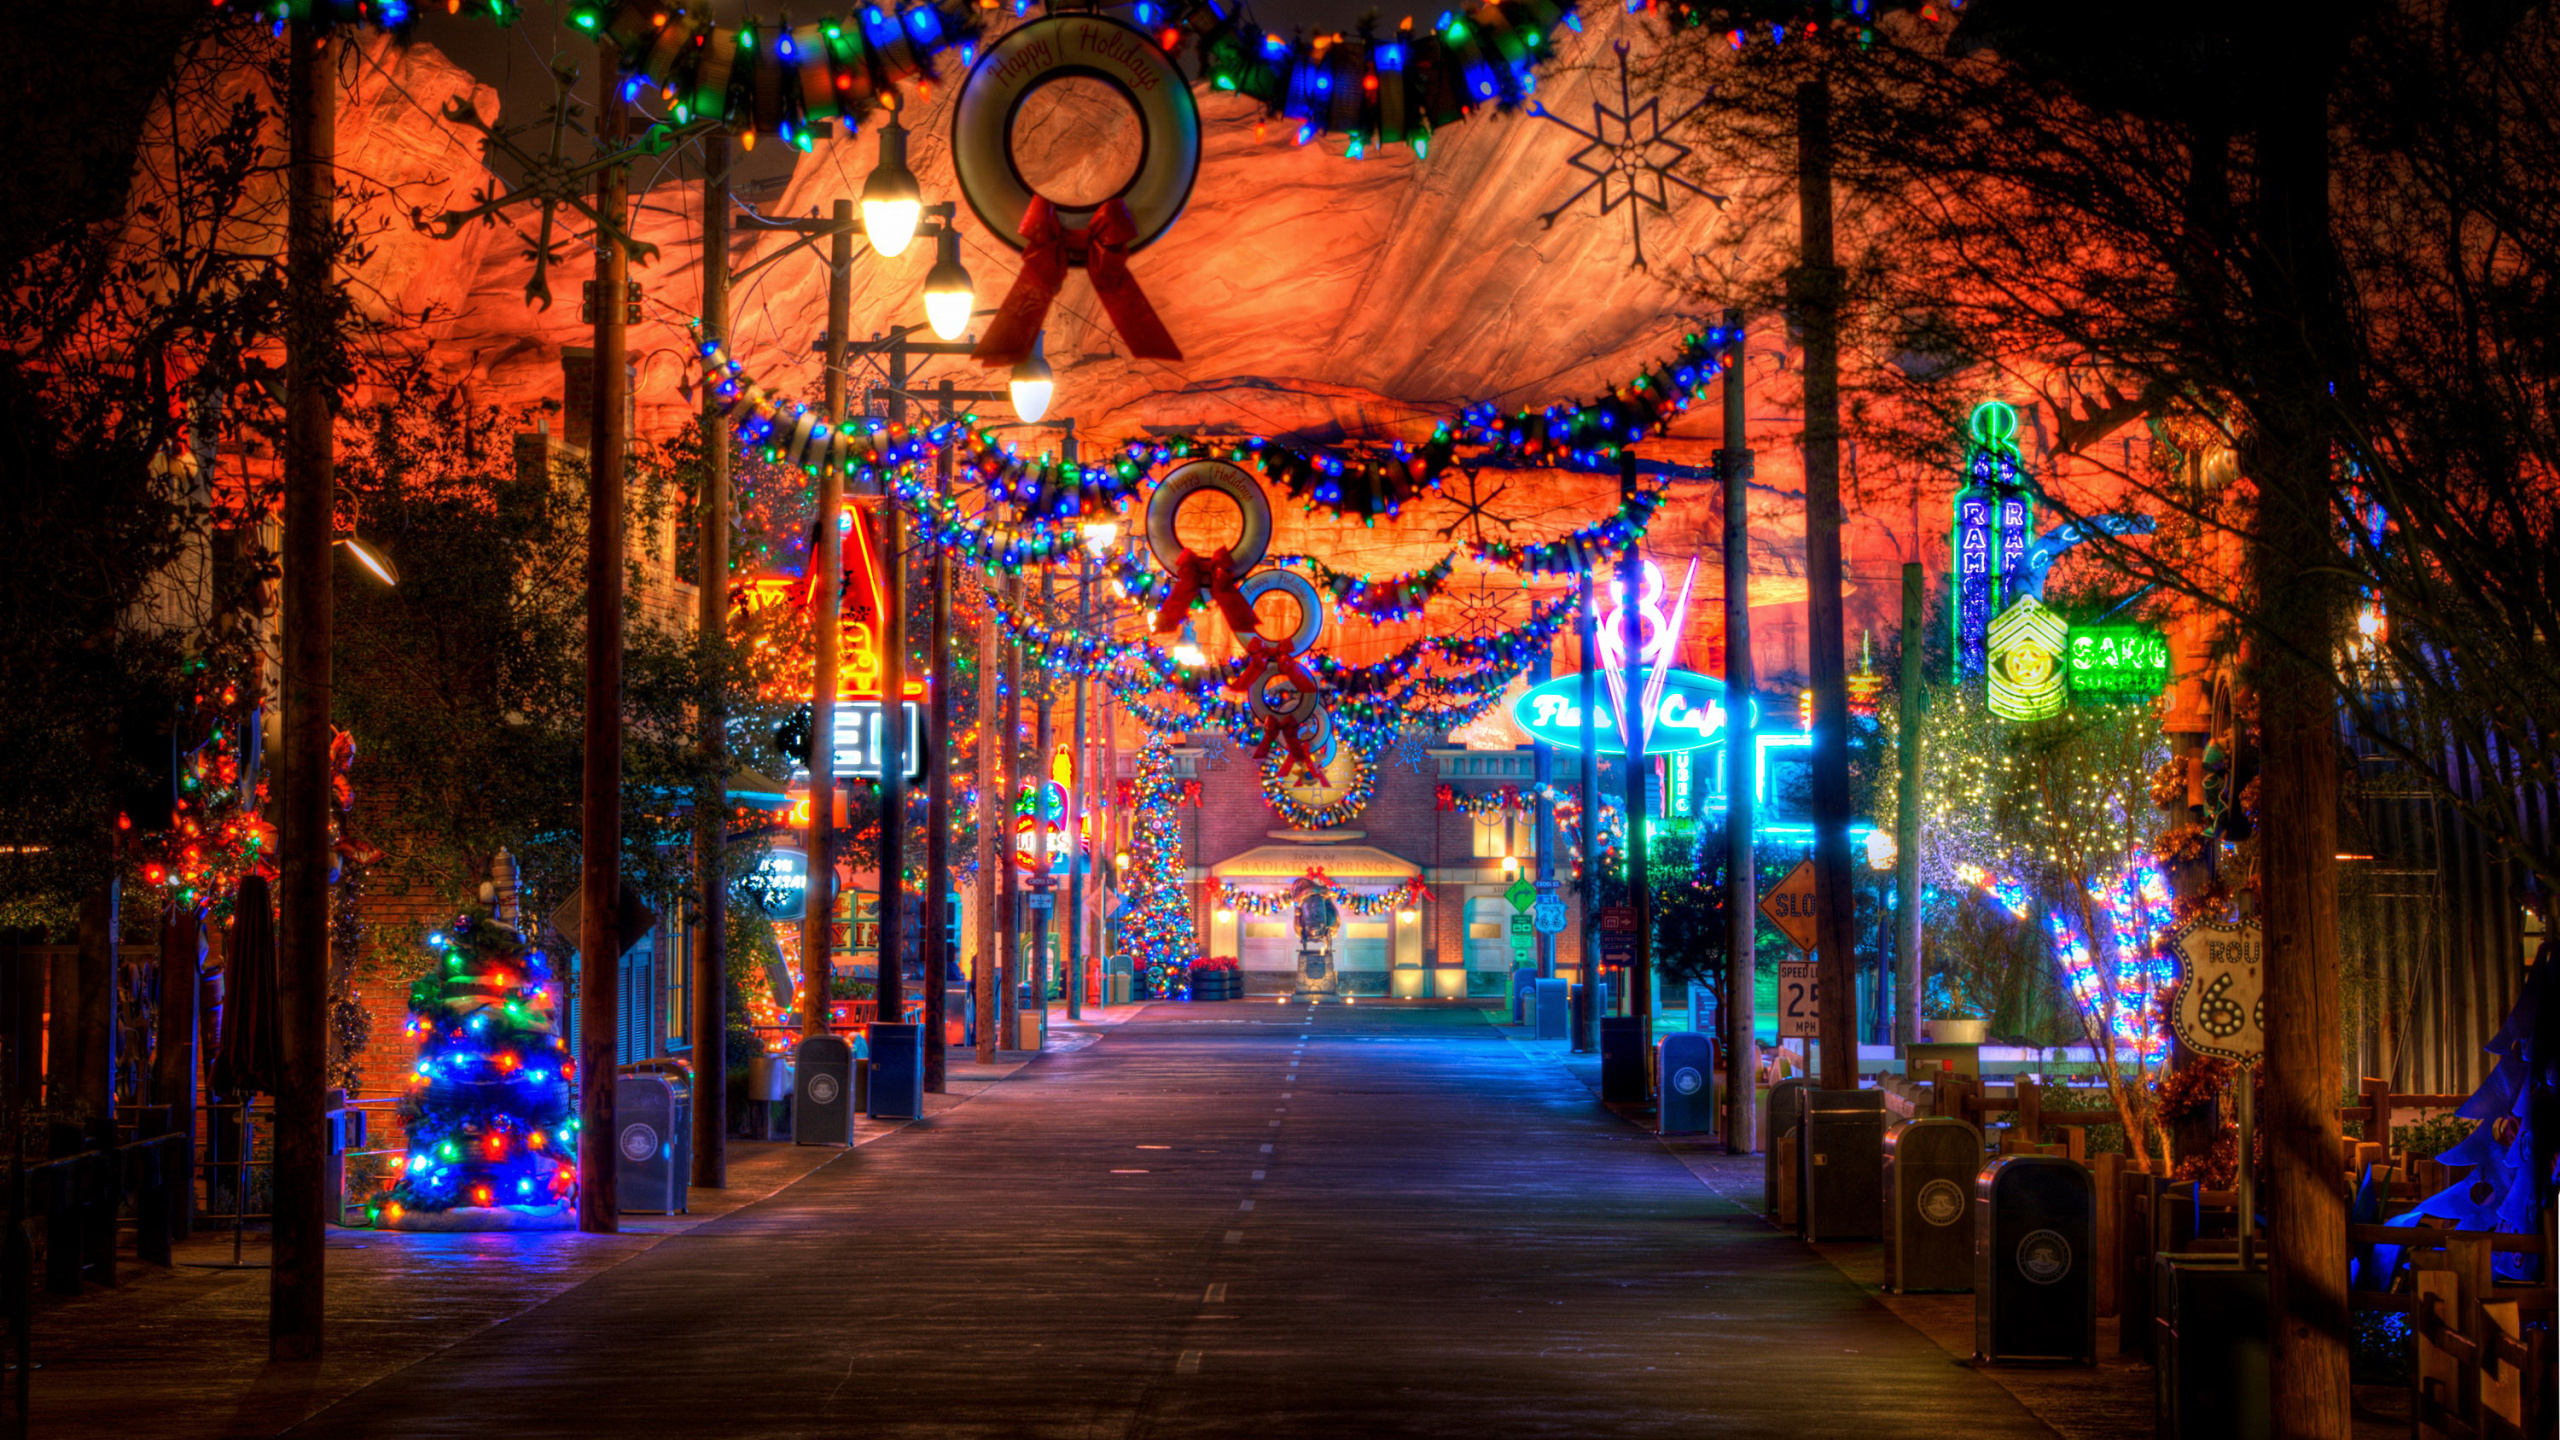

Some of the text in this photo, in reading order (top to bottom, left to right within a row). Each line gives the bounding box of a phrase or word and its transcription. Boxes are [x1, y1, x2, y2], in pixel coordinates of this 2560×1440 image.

[987, 24, 1159, 91] Happy Holidays
[1168, 465, 1254, 502] Happy Holidays
[1293, 853, 1335, 861] TOWN OF
[1241, 861, 1393, 873] RADIATOR SPRINGS
[1541, 912, 1562, 928] 66
[1781, 966, 1808, 978] SPEED
[2198, 971, 2264, 1037] 6
[1796, 1021, 1816, 1033] MPH
